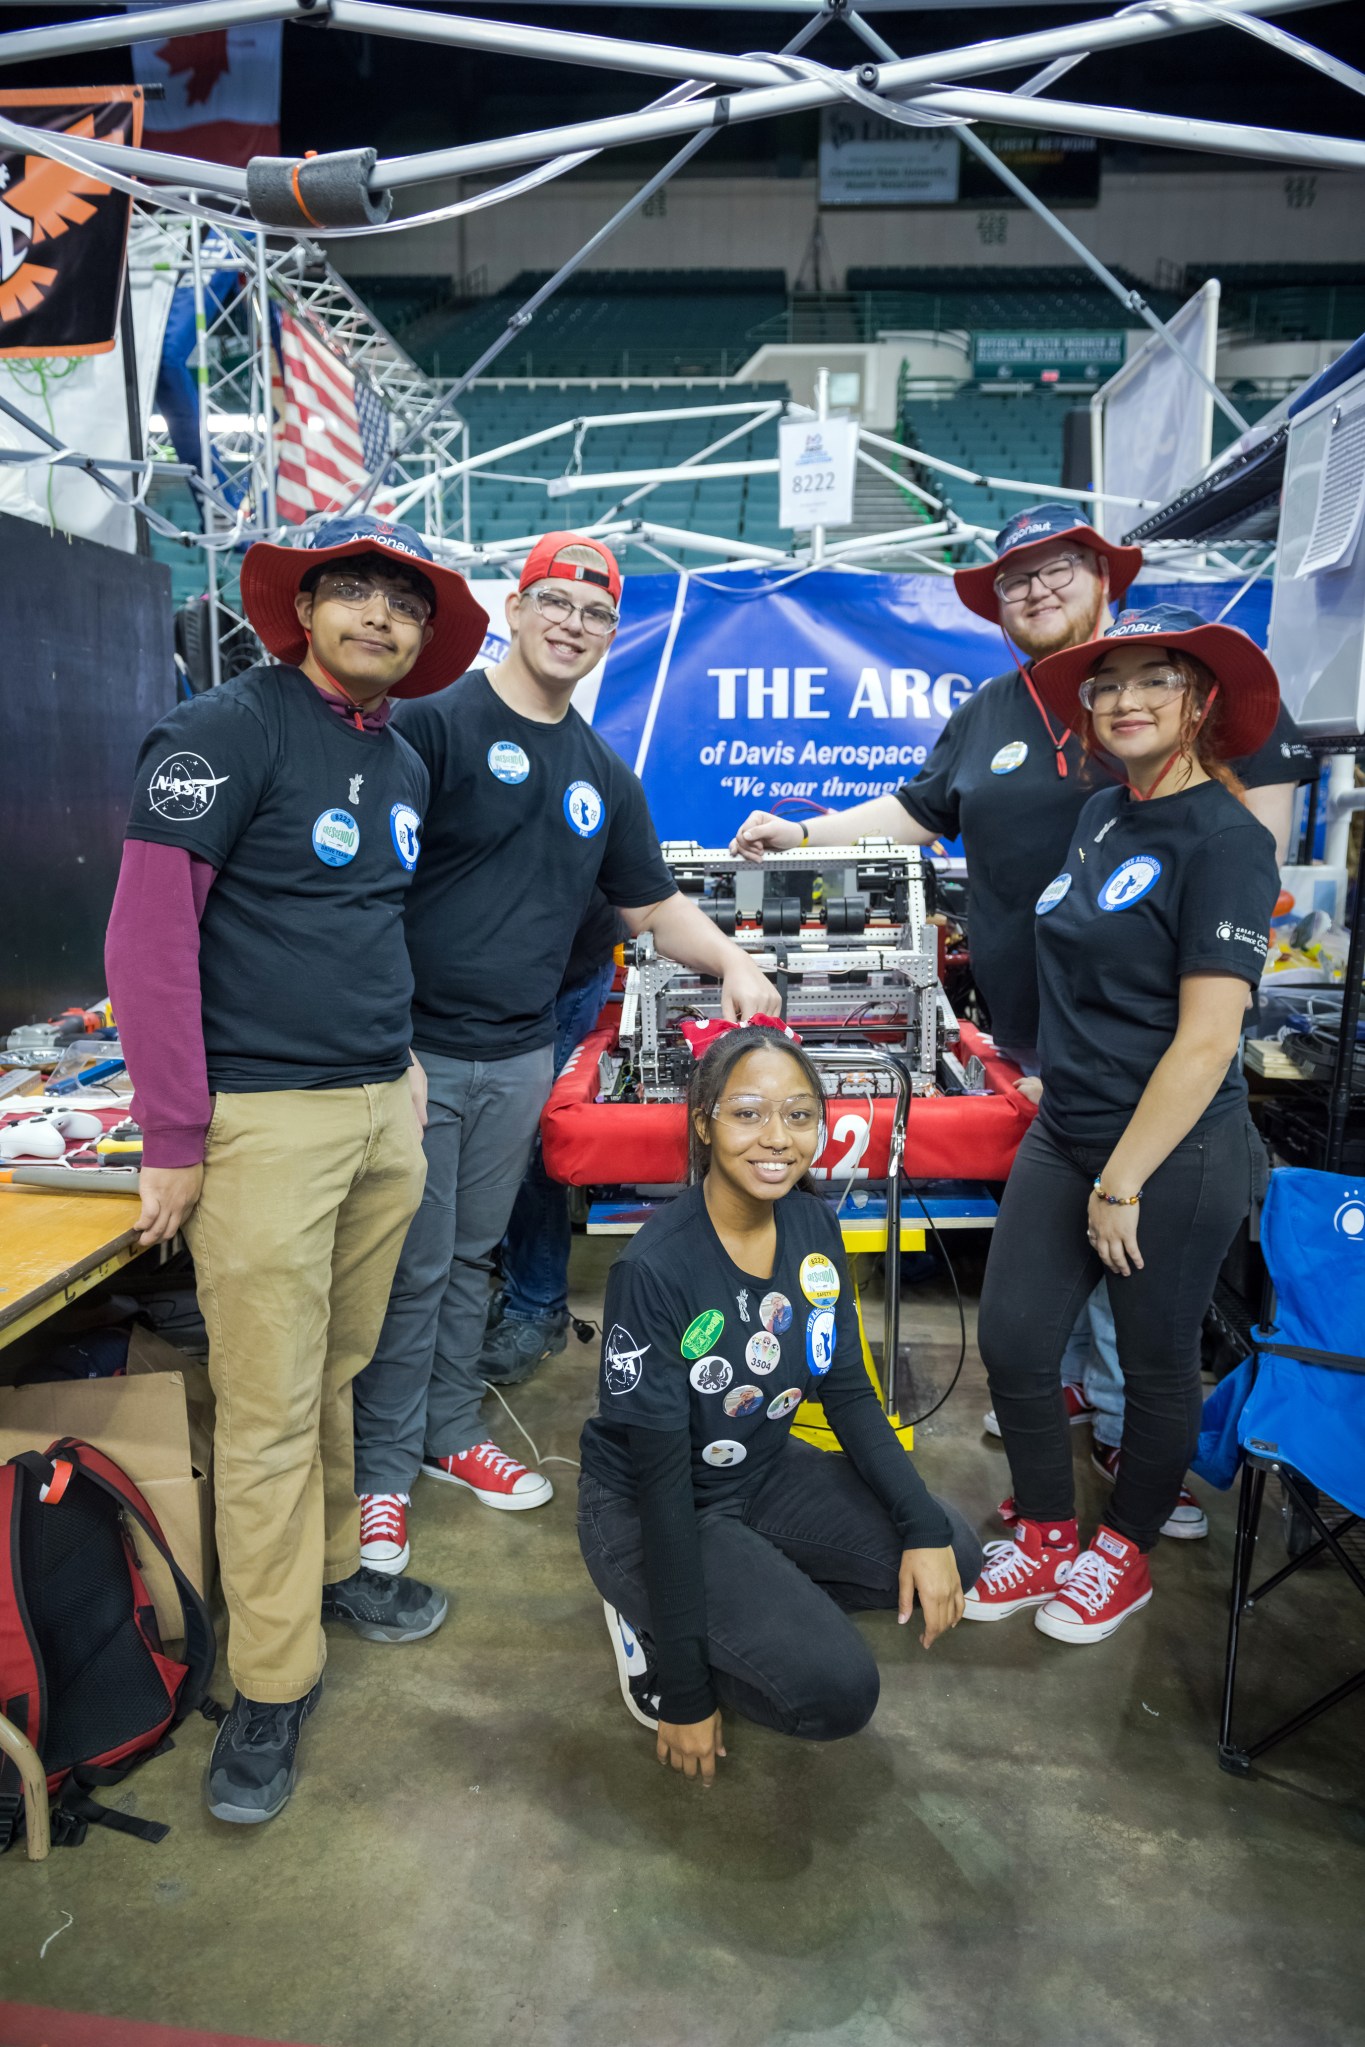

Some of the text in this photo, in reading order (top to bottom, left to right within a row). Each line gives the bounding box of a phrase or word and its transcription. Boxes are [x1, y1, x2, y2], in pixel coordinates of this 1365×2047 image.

[791, 471, 836, 494] 8222
[706, 667, 980, 720] THE ARG
[700, 740, 927, 771] of Davis Aerospace
[155, 775, 208, 804] NASA
[768, 782, 818, 798] soar
[334, 813, 351, 824] 8222
[322, 825, 355, 848] CRESCENDO
[1233, 932, 1257, 945] Science
[1235, 927, 1256, 936] GREAT
[810, 1257, 825, 1265] 8222
[750, 1357, 772, 1370] 3504
